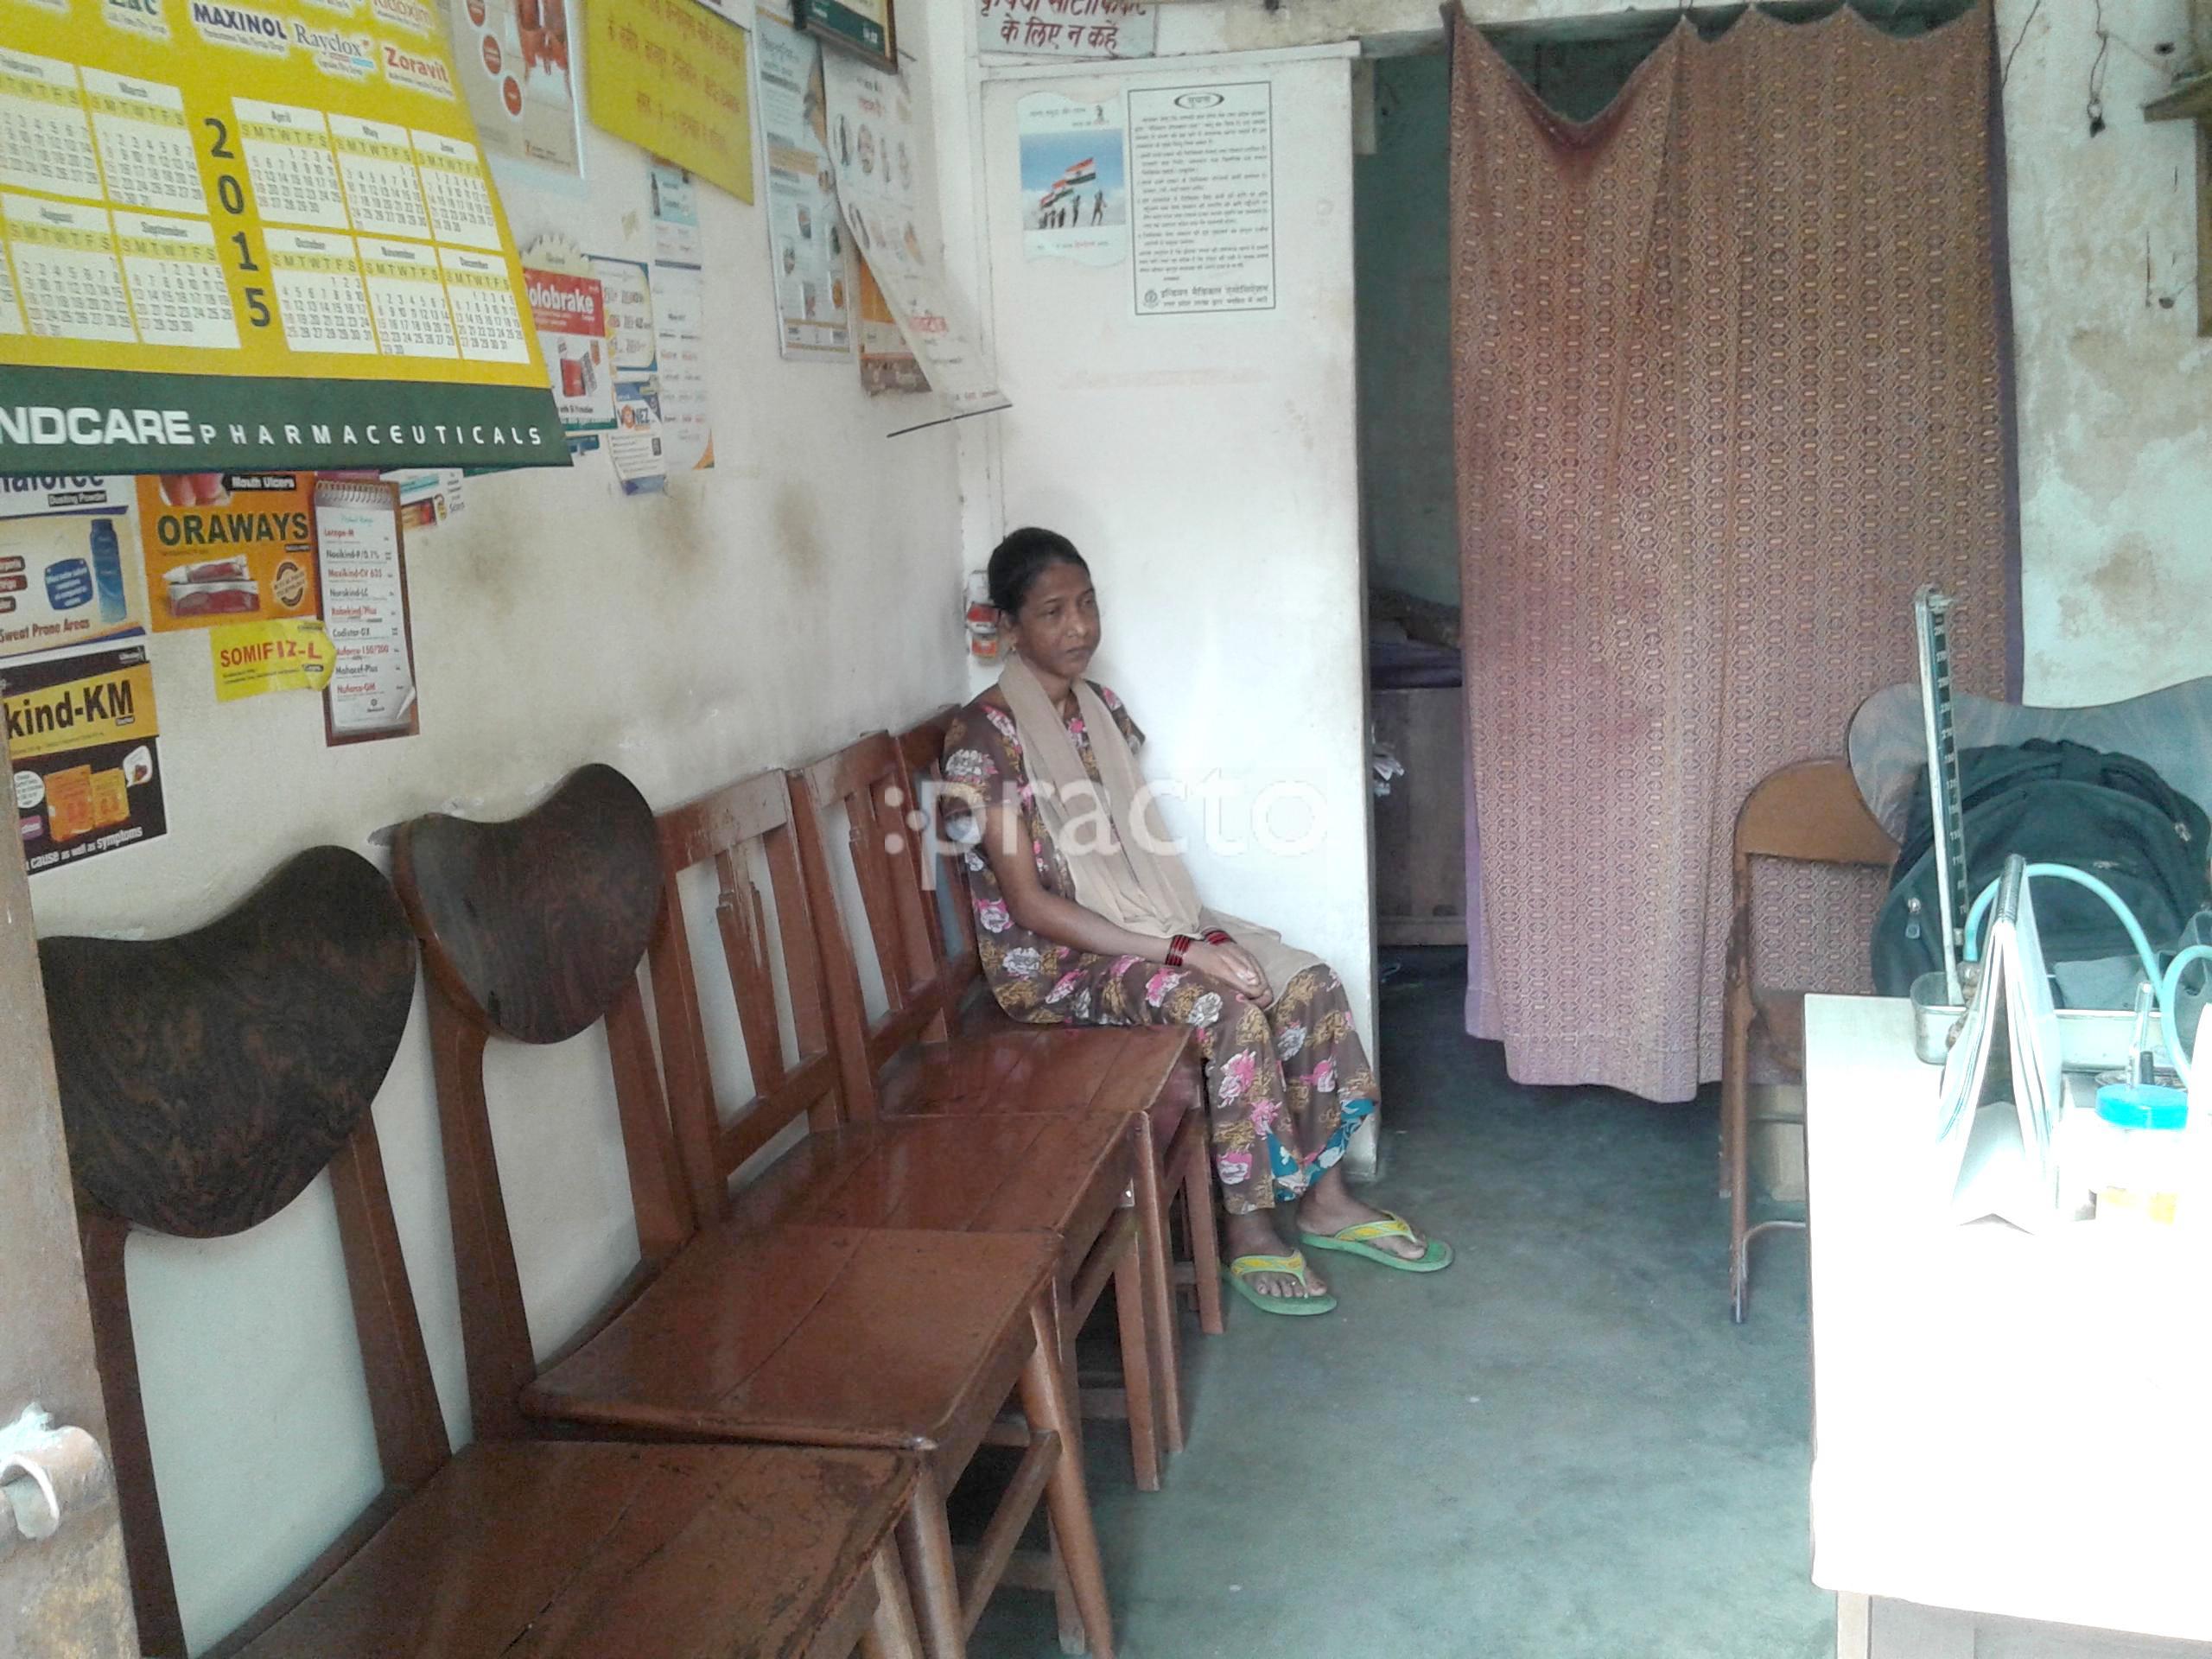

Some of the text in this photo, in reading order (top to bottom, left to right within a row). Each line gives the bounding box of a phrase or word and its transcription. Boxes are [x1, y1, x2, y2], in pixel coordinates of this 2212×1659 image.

[194, 3, 287, 39] MAXINOL
[1001, 13, 1020, 43] के
[1025, 16, 1063, 49] लिए
[1067, 24, 1085, 48] न
[295, 22, 362, 56] Rayclox
[385, 47, 448, 82] Zoravit
[529, 282, 594, 315] olobrake
[201, 424, 543, 447] PHARMACEUTICALS
[263, 476, 296, 488] Ulcers
[157, 512, 309, 546] ORAWAYS
[33, 623, 60, 639] Prone
[63, 618, 91, 632] Areas
[219, 639, 323, 668] SOMIFIZ-L
[30, 851, 60, 868] cause
[96, 826, 144, 850] symptoms
